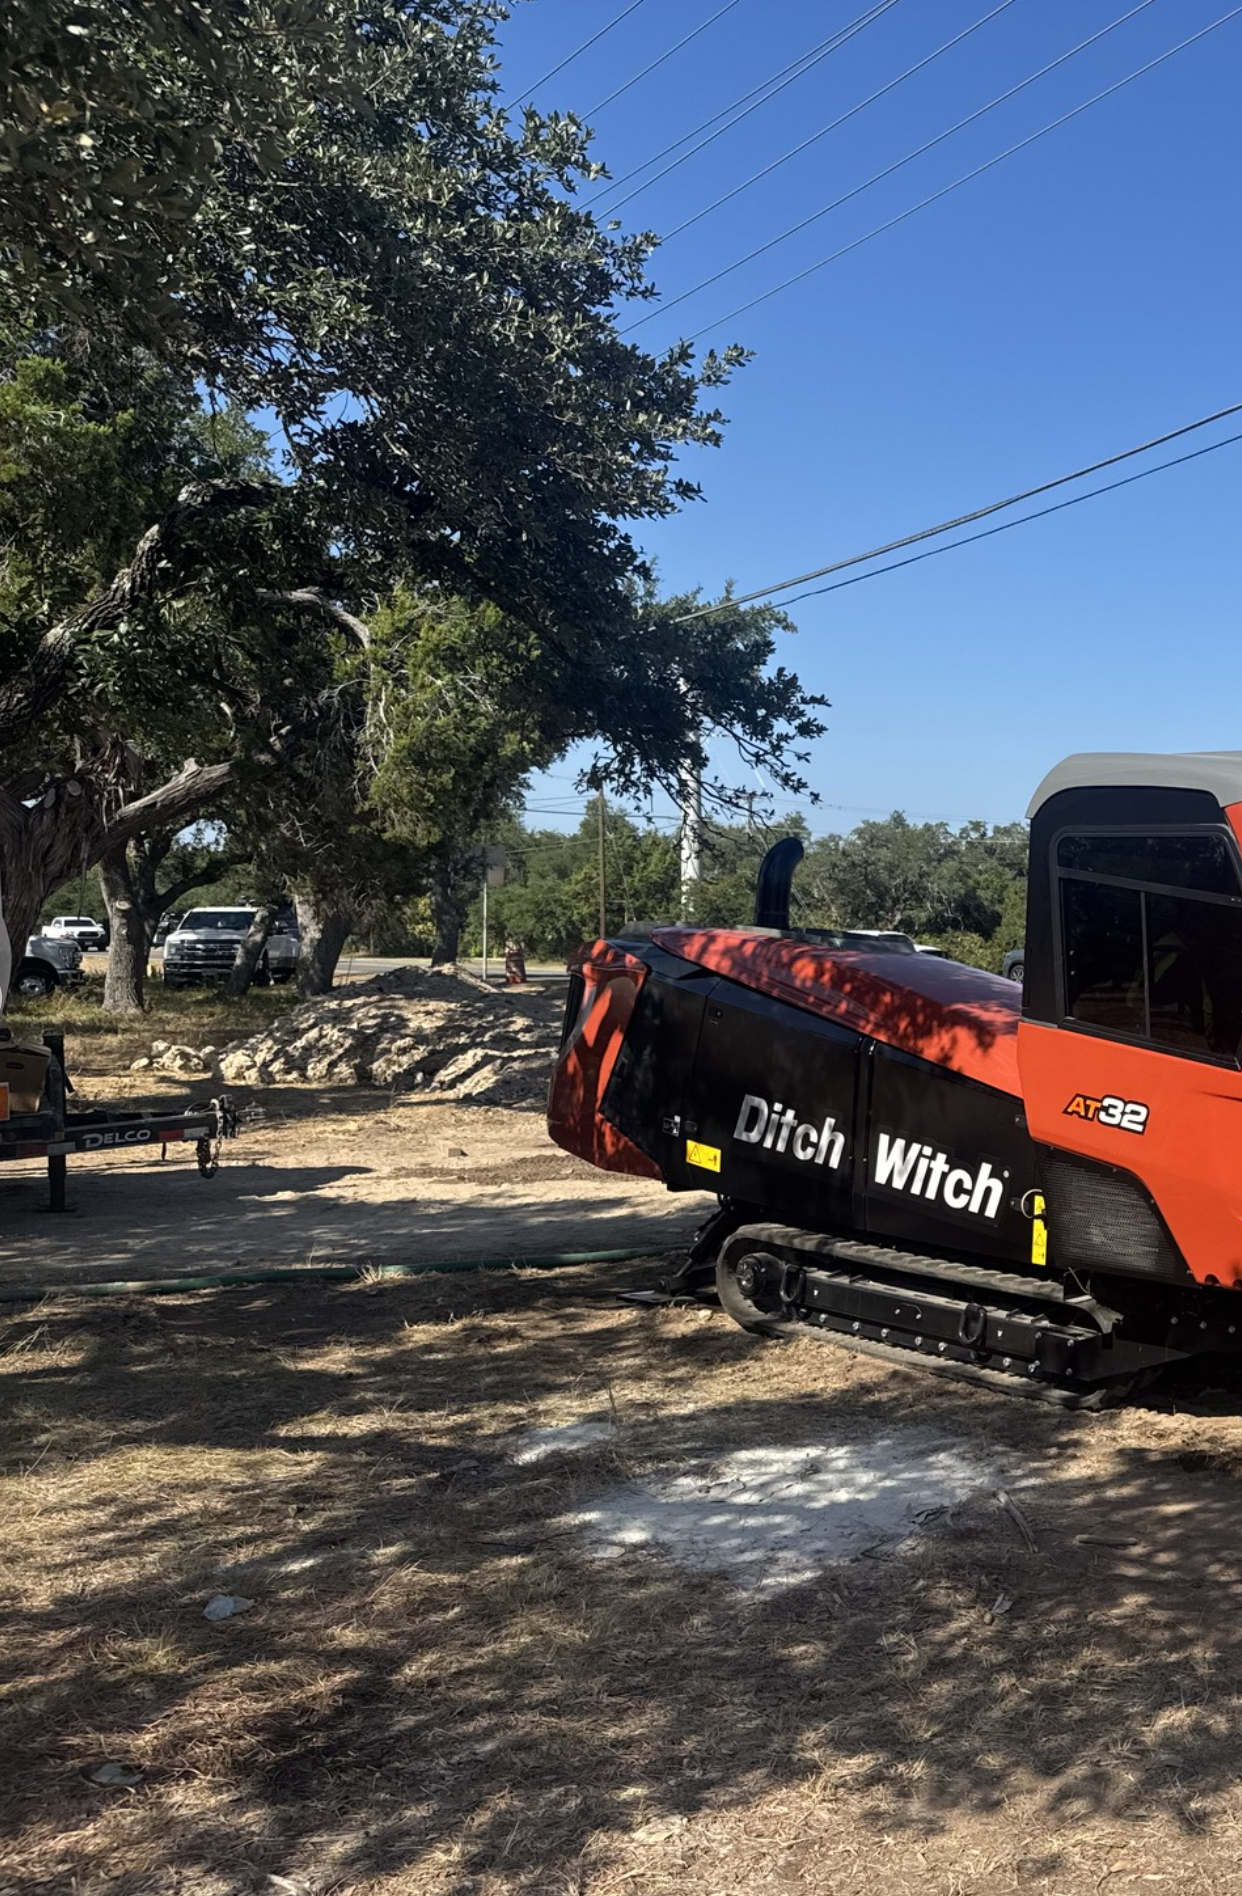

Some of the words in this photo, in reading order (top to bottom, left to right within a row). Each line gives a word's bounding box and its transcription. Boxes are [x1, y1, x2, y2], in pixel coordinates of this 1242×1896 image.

[1064, 1094, 1149, 1134] AT32
[82, 1129, 151, 1148] DELCO
[733, 1094, 845, 1170] Ditch
[874, 1132, 1005, 1219] Witch
